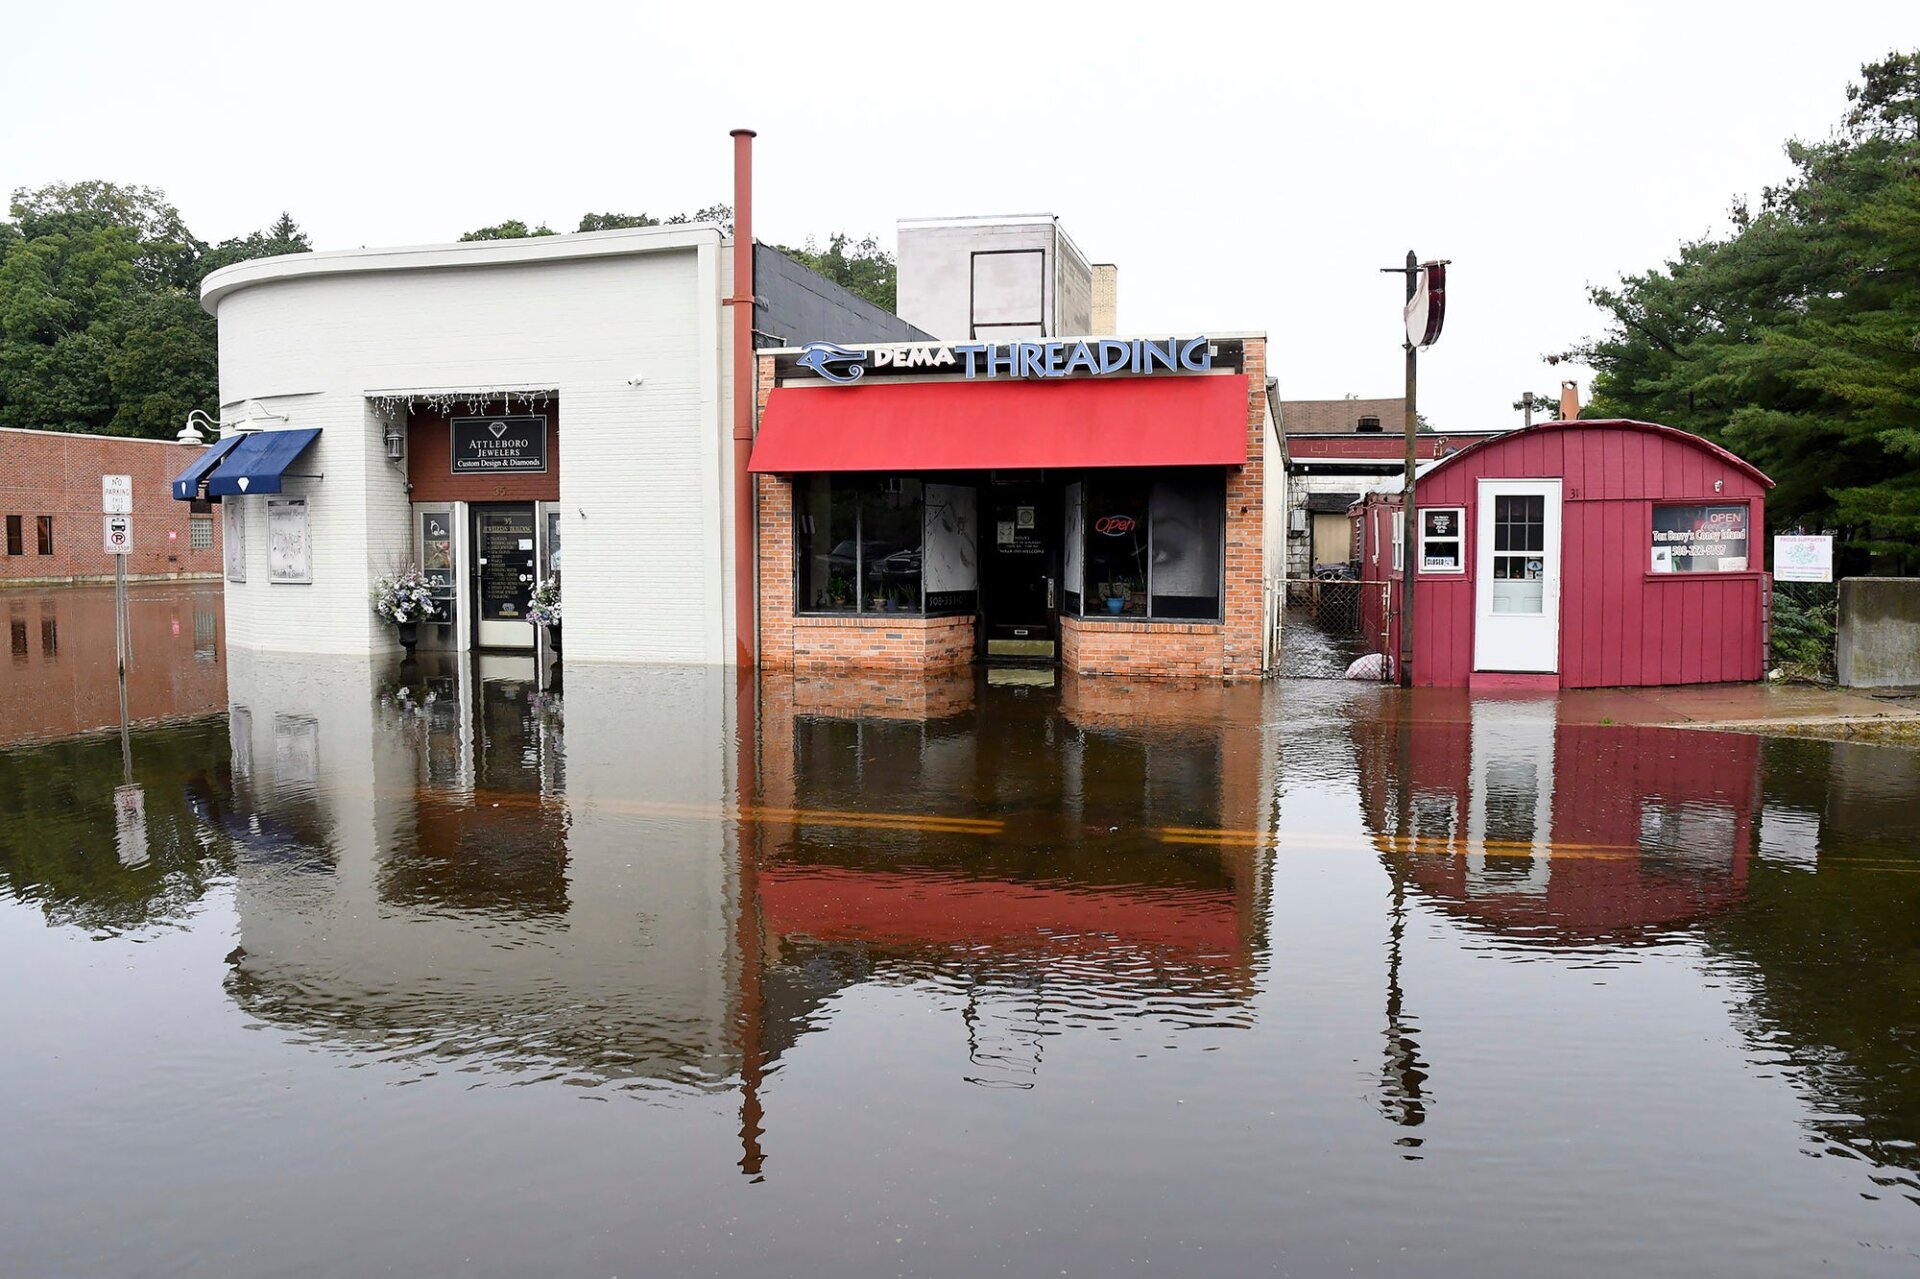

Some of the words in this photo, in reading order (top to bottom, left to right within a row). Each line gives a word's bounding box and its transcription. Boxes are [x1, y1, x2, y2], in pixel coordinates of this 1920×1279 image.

[874, 346, 957, 368] DEMA
[953, 335, 1212, 379] THREADING
[469, 439, 529, 449] ATTLEBORO
[477, 449, 520, 458] JEWELERS
[481, 459, 502, 468] Design
[510, 458, 540, 466] Diamonds
[112, 479, 123, 487] NO
[105, 488, 130, 496] PARKING
[493, 485, 506, 496] 35
[1569, 488, 1579, 499] 31
[1710, 513, 1742, 523] OPEN
[1095, 516, 1137, 533] Open
[1695, 529, 1721, 542] Coney
